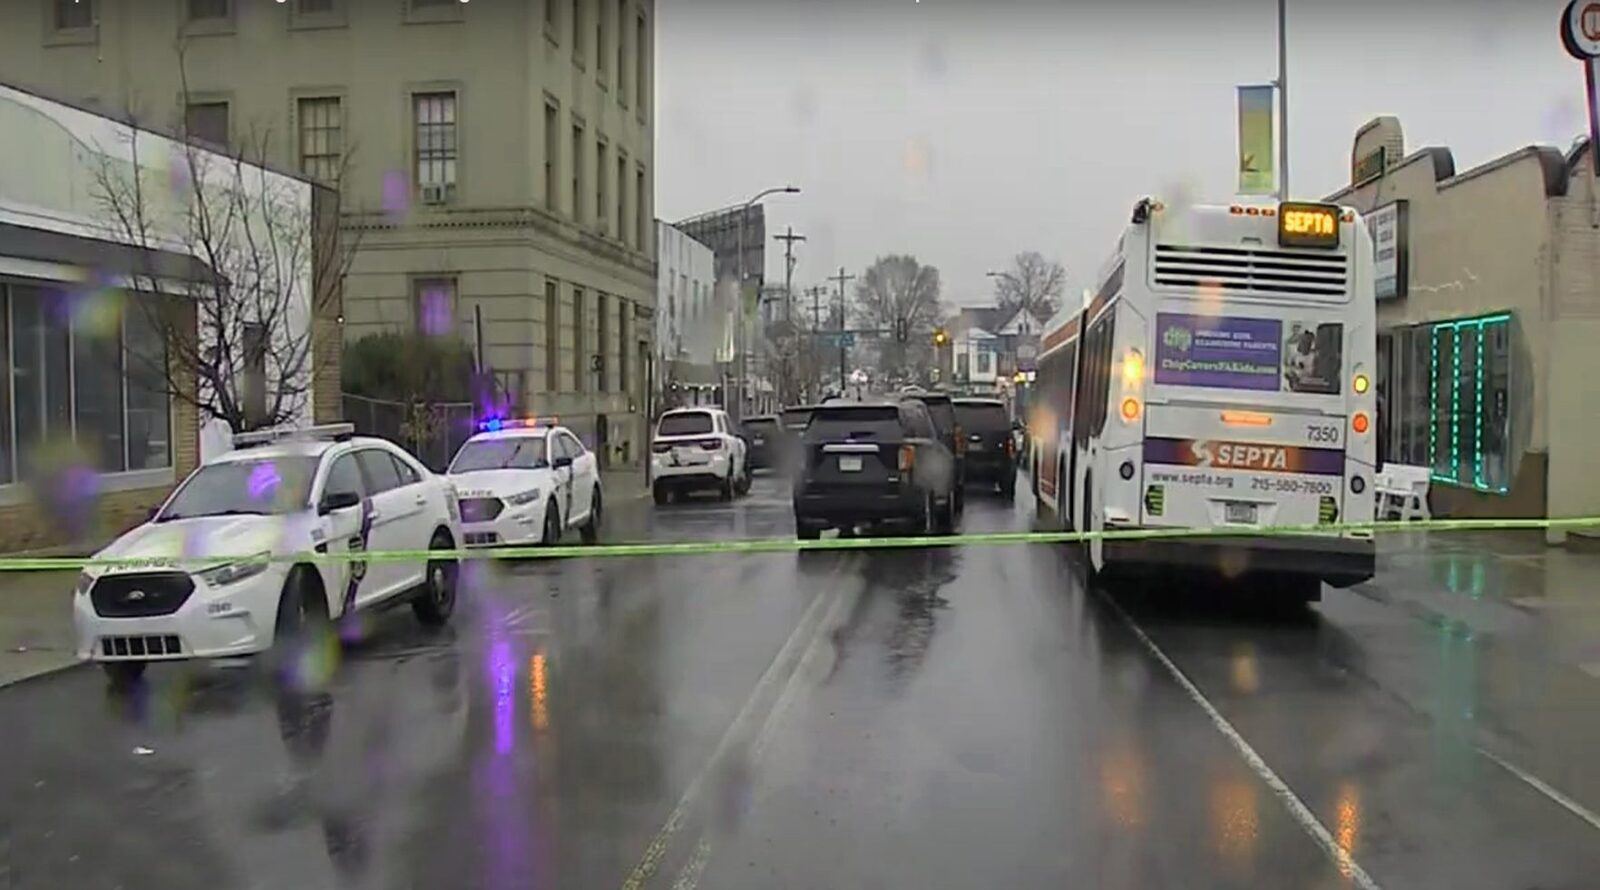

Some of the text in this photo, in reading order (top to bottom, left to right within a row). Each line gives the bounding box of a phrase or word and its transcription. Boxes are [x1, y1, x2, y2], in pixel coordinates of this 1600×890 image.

[1284, 210, 1333, 233] SEPTA
[1307, 425, 1338, 443] 7350
[1217, 444, 1288, 469] SEPTA
[1152, 473, 1234, 489] www.septa.org
